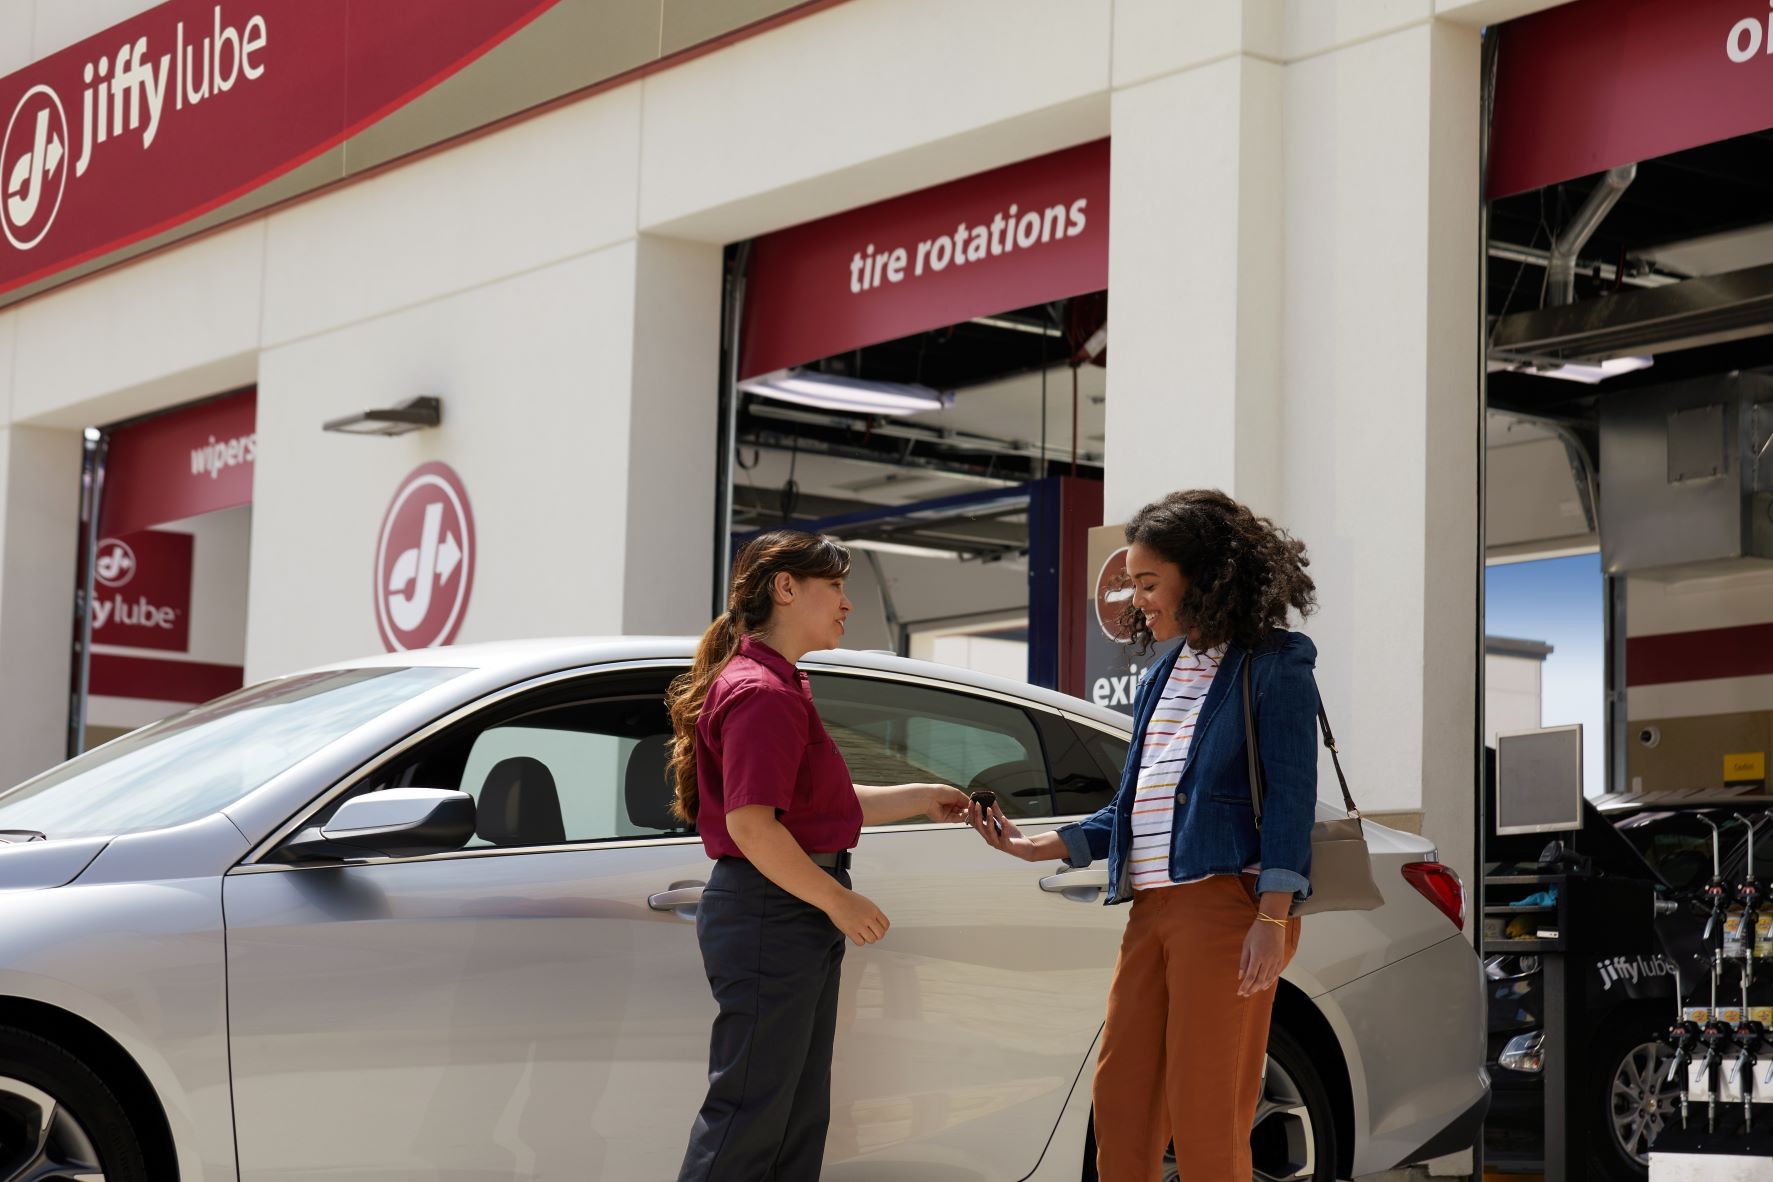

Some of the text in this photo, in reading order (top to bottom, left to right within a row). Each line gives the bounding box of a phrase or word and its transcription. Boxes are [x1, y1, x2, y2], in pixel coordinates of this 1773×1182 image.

[76, 5, 267, 178] jiffy lube
[850, 198, 1087, 294] tire rotations
[191, 432, 257, 479] wipers
[1597, 956, 1637, 991] jiffy
